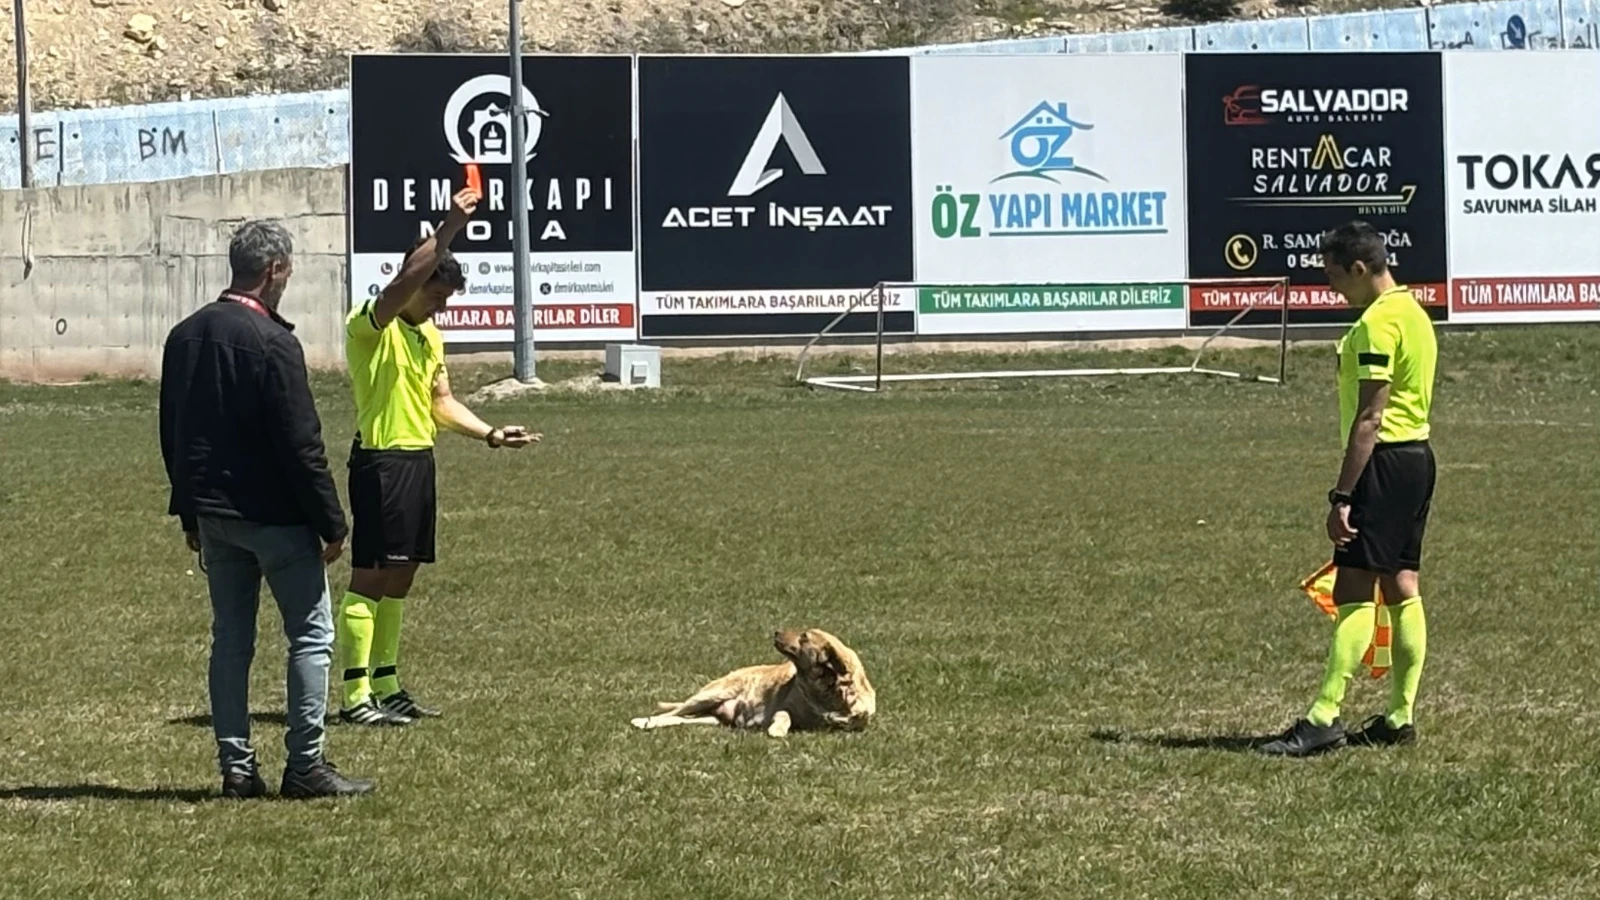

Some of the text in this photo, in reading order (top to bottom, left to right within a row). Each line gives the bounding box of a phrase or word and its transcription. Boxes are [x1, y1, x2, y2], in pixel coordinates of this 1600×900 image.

[1261, 89, 1409, 113] SALVADOR
[1253, 173, 1389, 194] SALVADOR
[373, 178, 613, 211] DEMRAPI
[1463, 194, 1597, 214] SAVUNMA SİLAH
[661, 202, 893, 232] ACET İNŞAAT
[931, 185, 1167, 238] ÖZ YAPI MARKET
[420, 220, 567, 242] MOA
[1262, 234, 1278, 249] R.
[1287, 254, 1297, 268] 0
[656, 294, 684, 310] TÜM
[688, 295, 766, 310] TAKIMLARA
[769, 294, 845, 311] BAŞARILAR
[932, 289, 1172, 309] TÜM TAKIMLARA BAŞARILAR DİLERİZ
[1202, 289, 1231, 306] TÜM
[1460, 280, 1493, 305] TÜM
[1496, 282, 1576, 305] TAKIMLARA
[580, 304, 620, 325] DİLER
